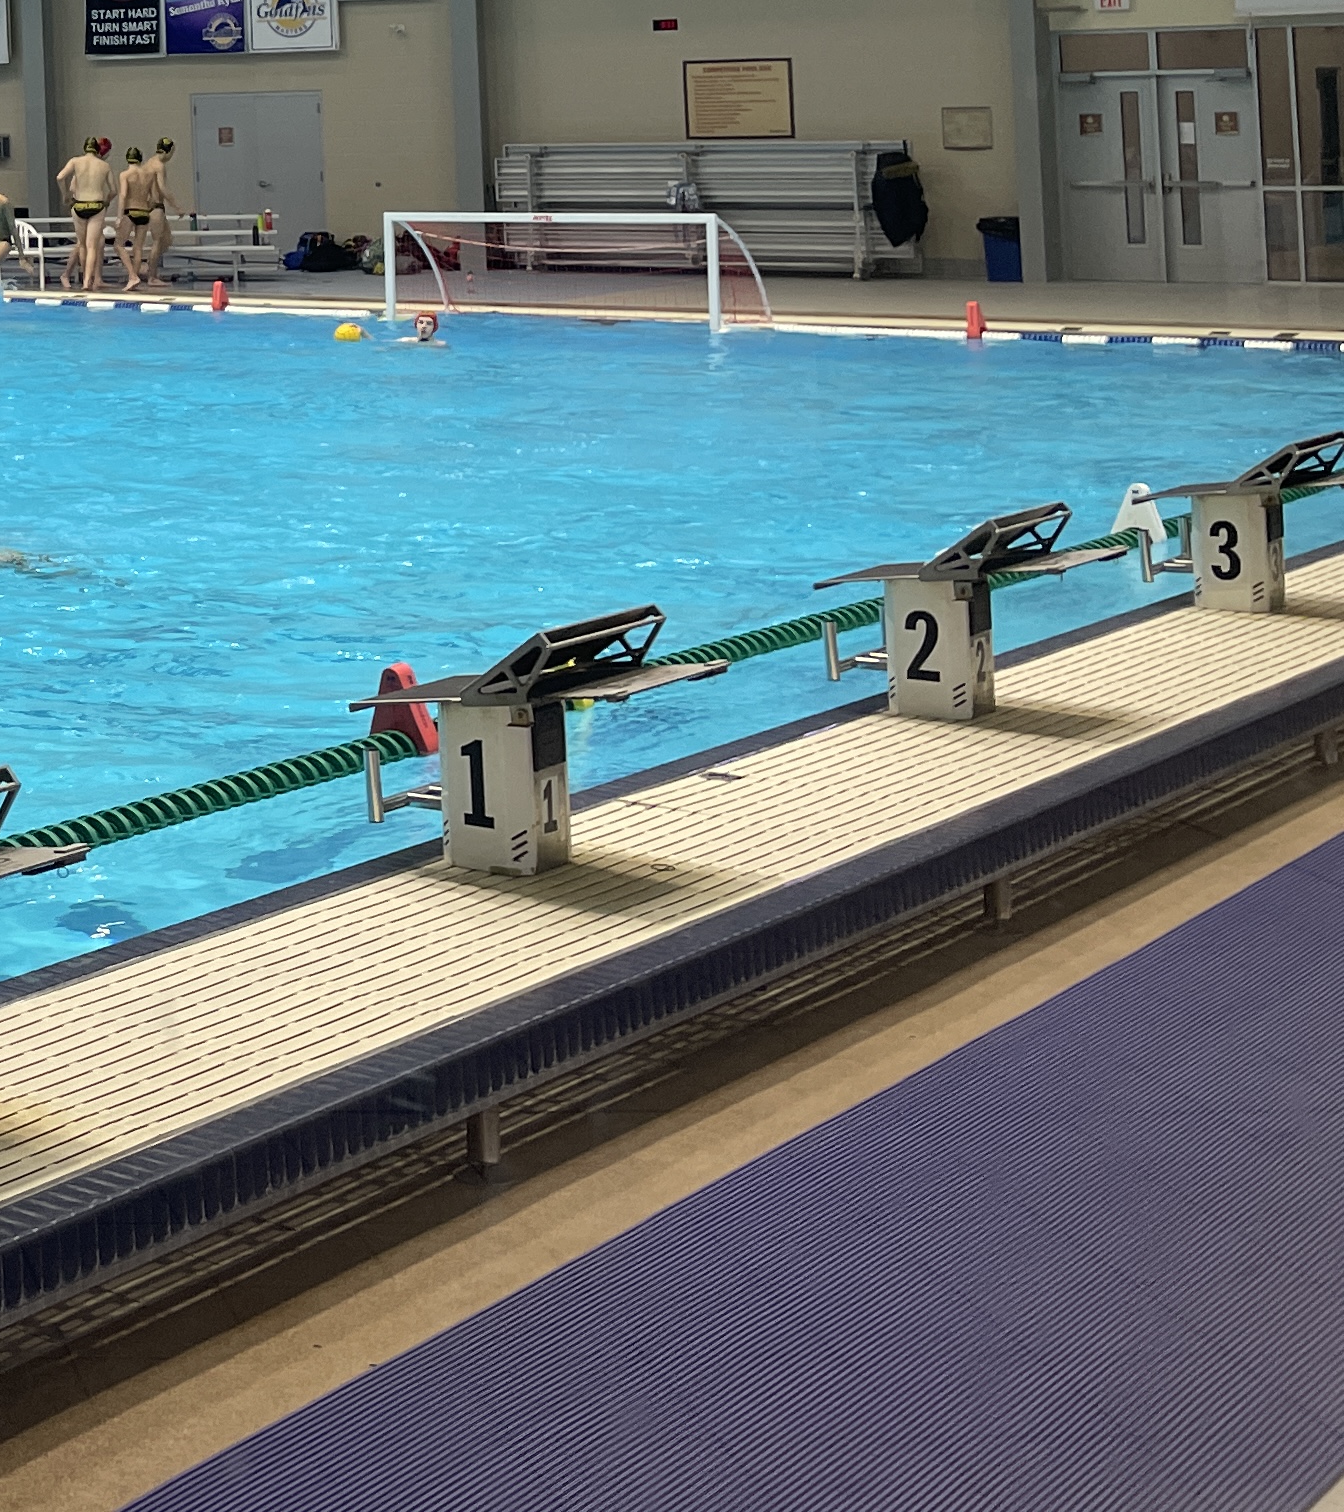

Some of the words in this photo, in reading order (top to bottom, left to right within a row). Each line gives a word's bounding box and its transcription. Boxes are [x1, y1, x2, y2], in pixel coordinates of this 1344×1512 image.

[91, 8, 126, 20] START
[127, 7, 157, 18] HARD
[91, 22, 120, 33] TURN
[121, 21, 158, 32] SMART
[92, 35, 128, 46] FINISH
[128, 34, 156, 45] FAST
[1209, 520, 1241, 580] 3
[904, 610, 940, 682] 2
[976, 639, 986, 683] 2
[460, 739, 495, 829] 1
[542, 779, 558, 834] 1
